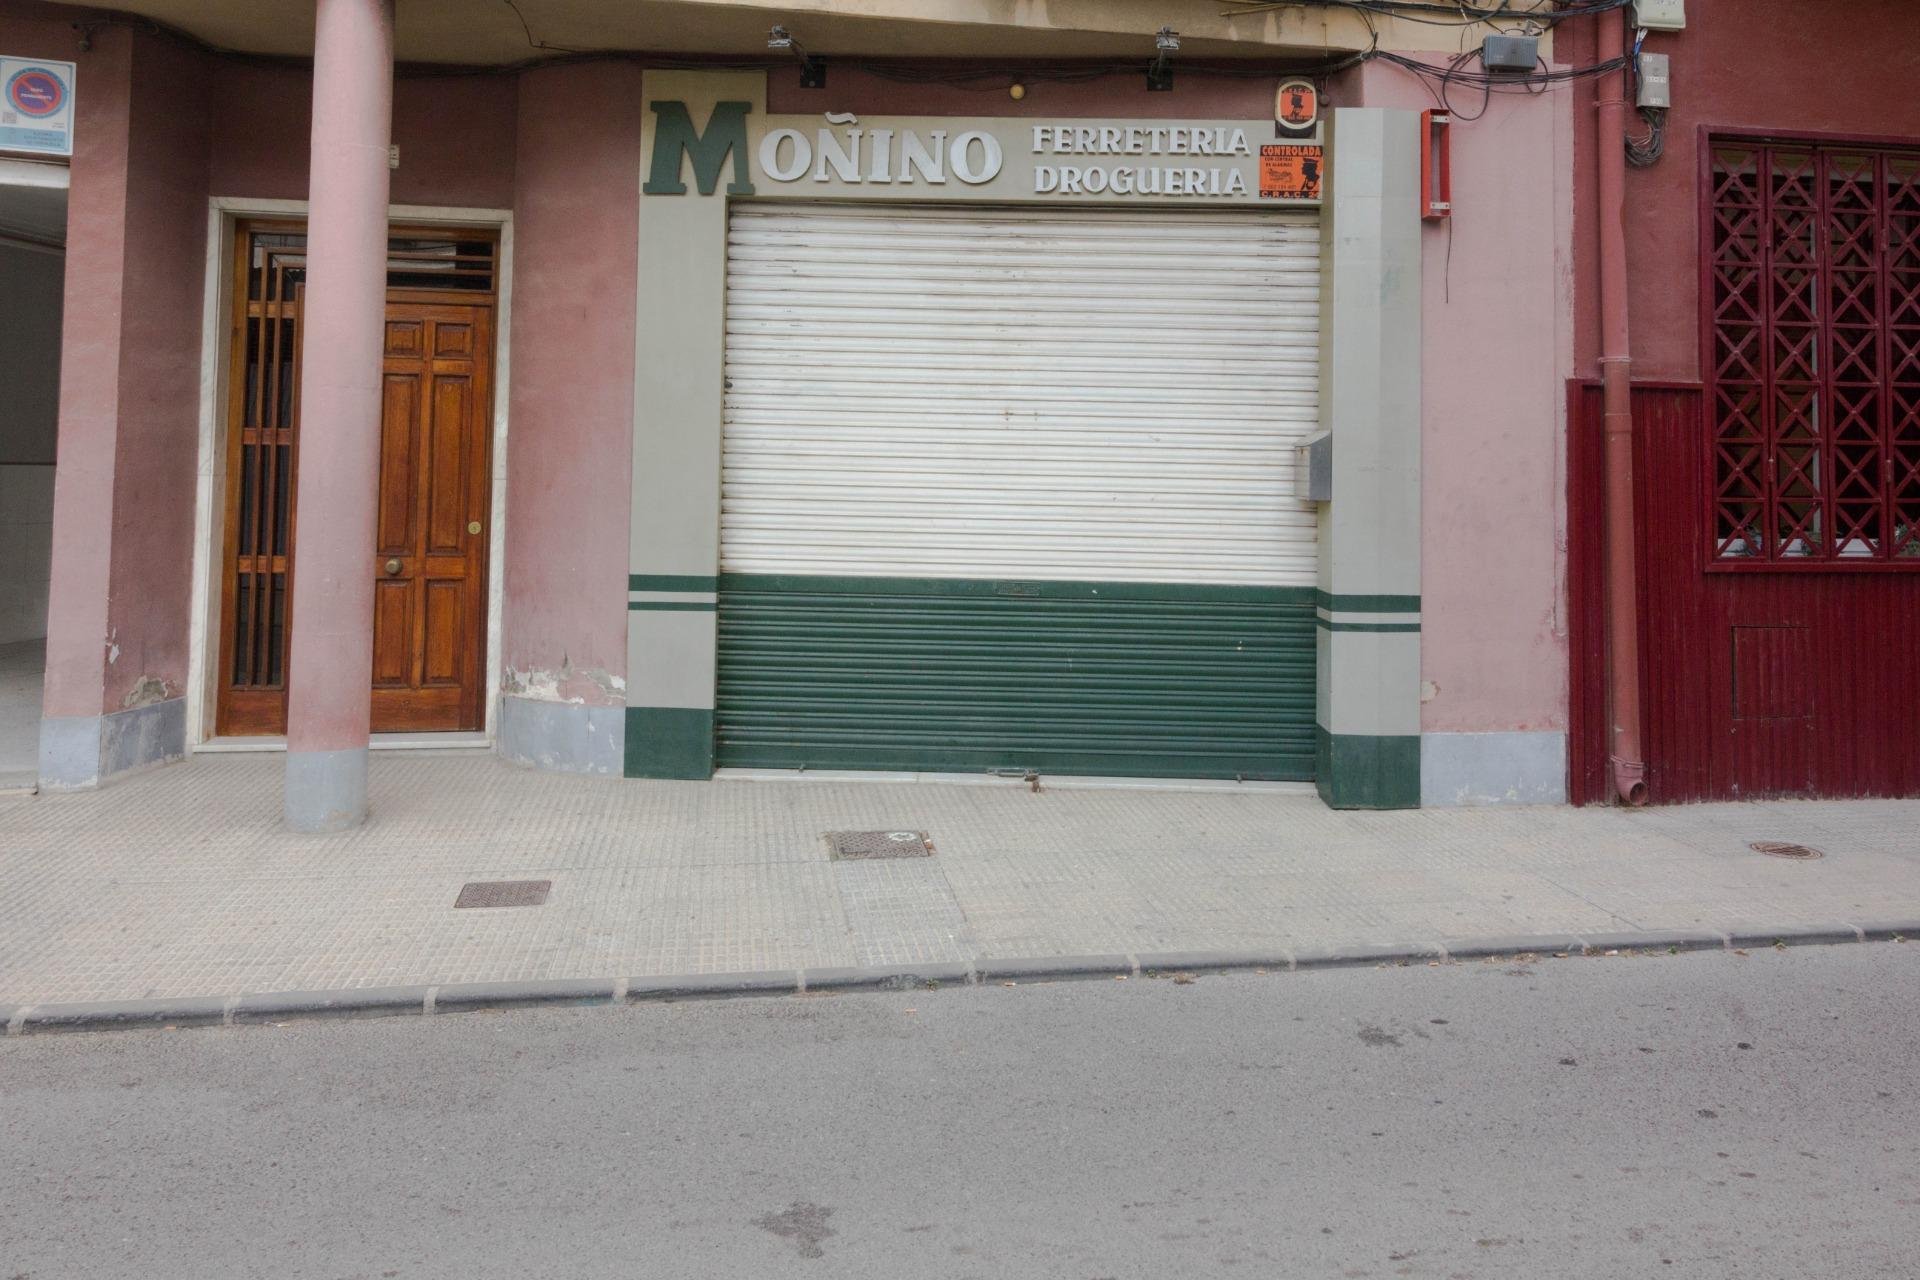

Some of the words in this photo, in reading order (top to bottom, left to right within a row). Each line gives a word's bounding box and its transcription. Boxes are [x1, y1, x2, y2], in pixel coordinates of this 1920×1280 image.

[643, 101, 1003, 195] MOÑINO
[1032, 126, 1251, 155] FERRETERIA
[1262, 146, 1321, 157] CONTROLADA
[1034, 166, 1248, 196] DROGUERIA
